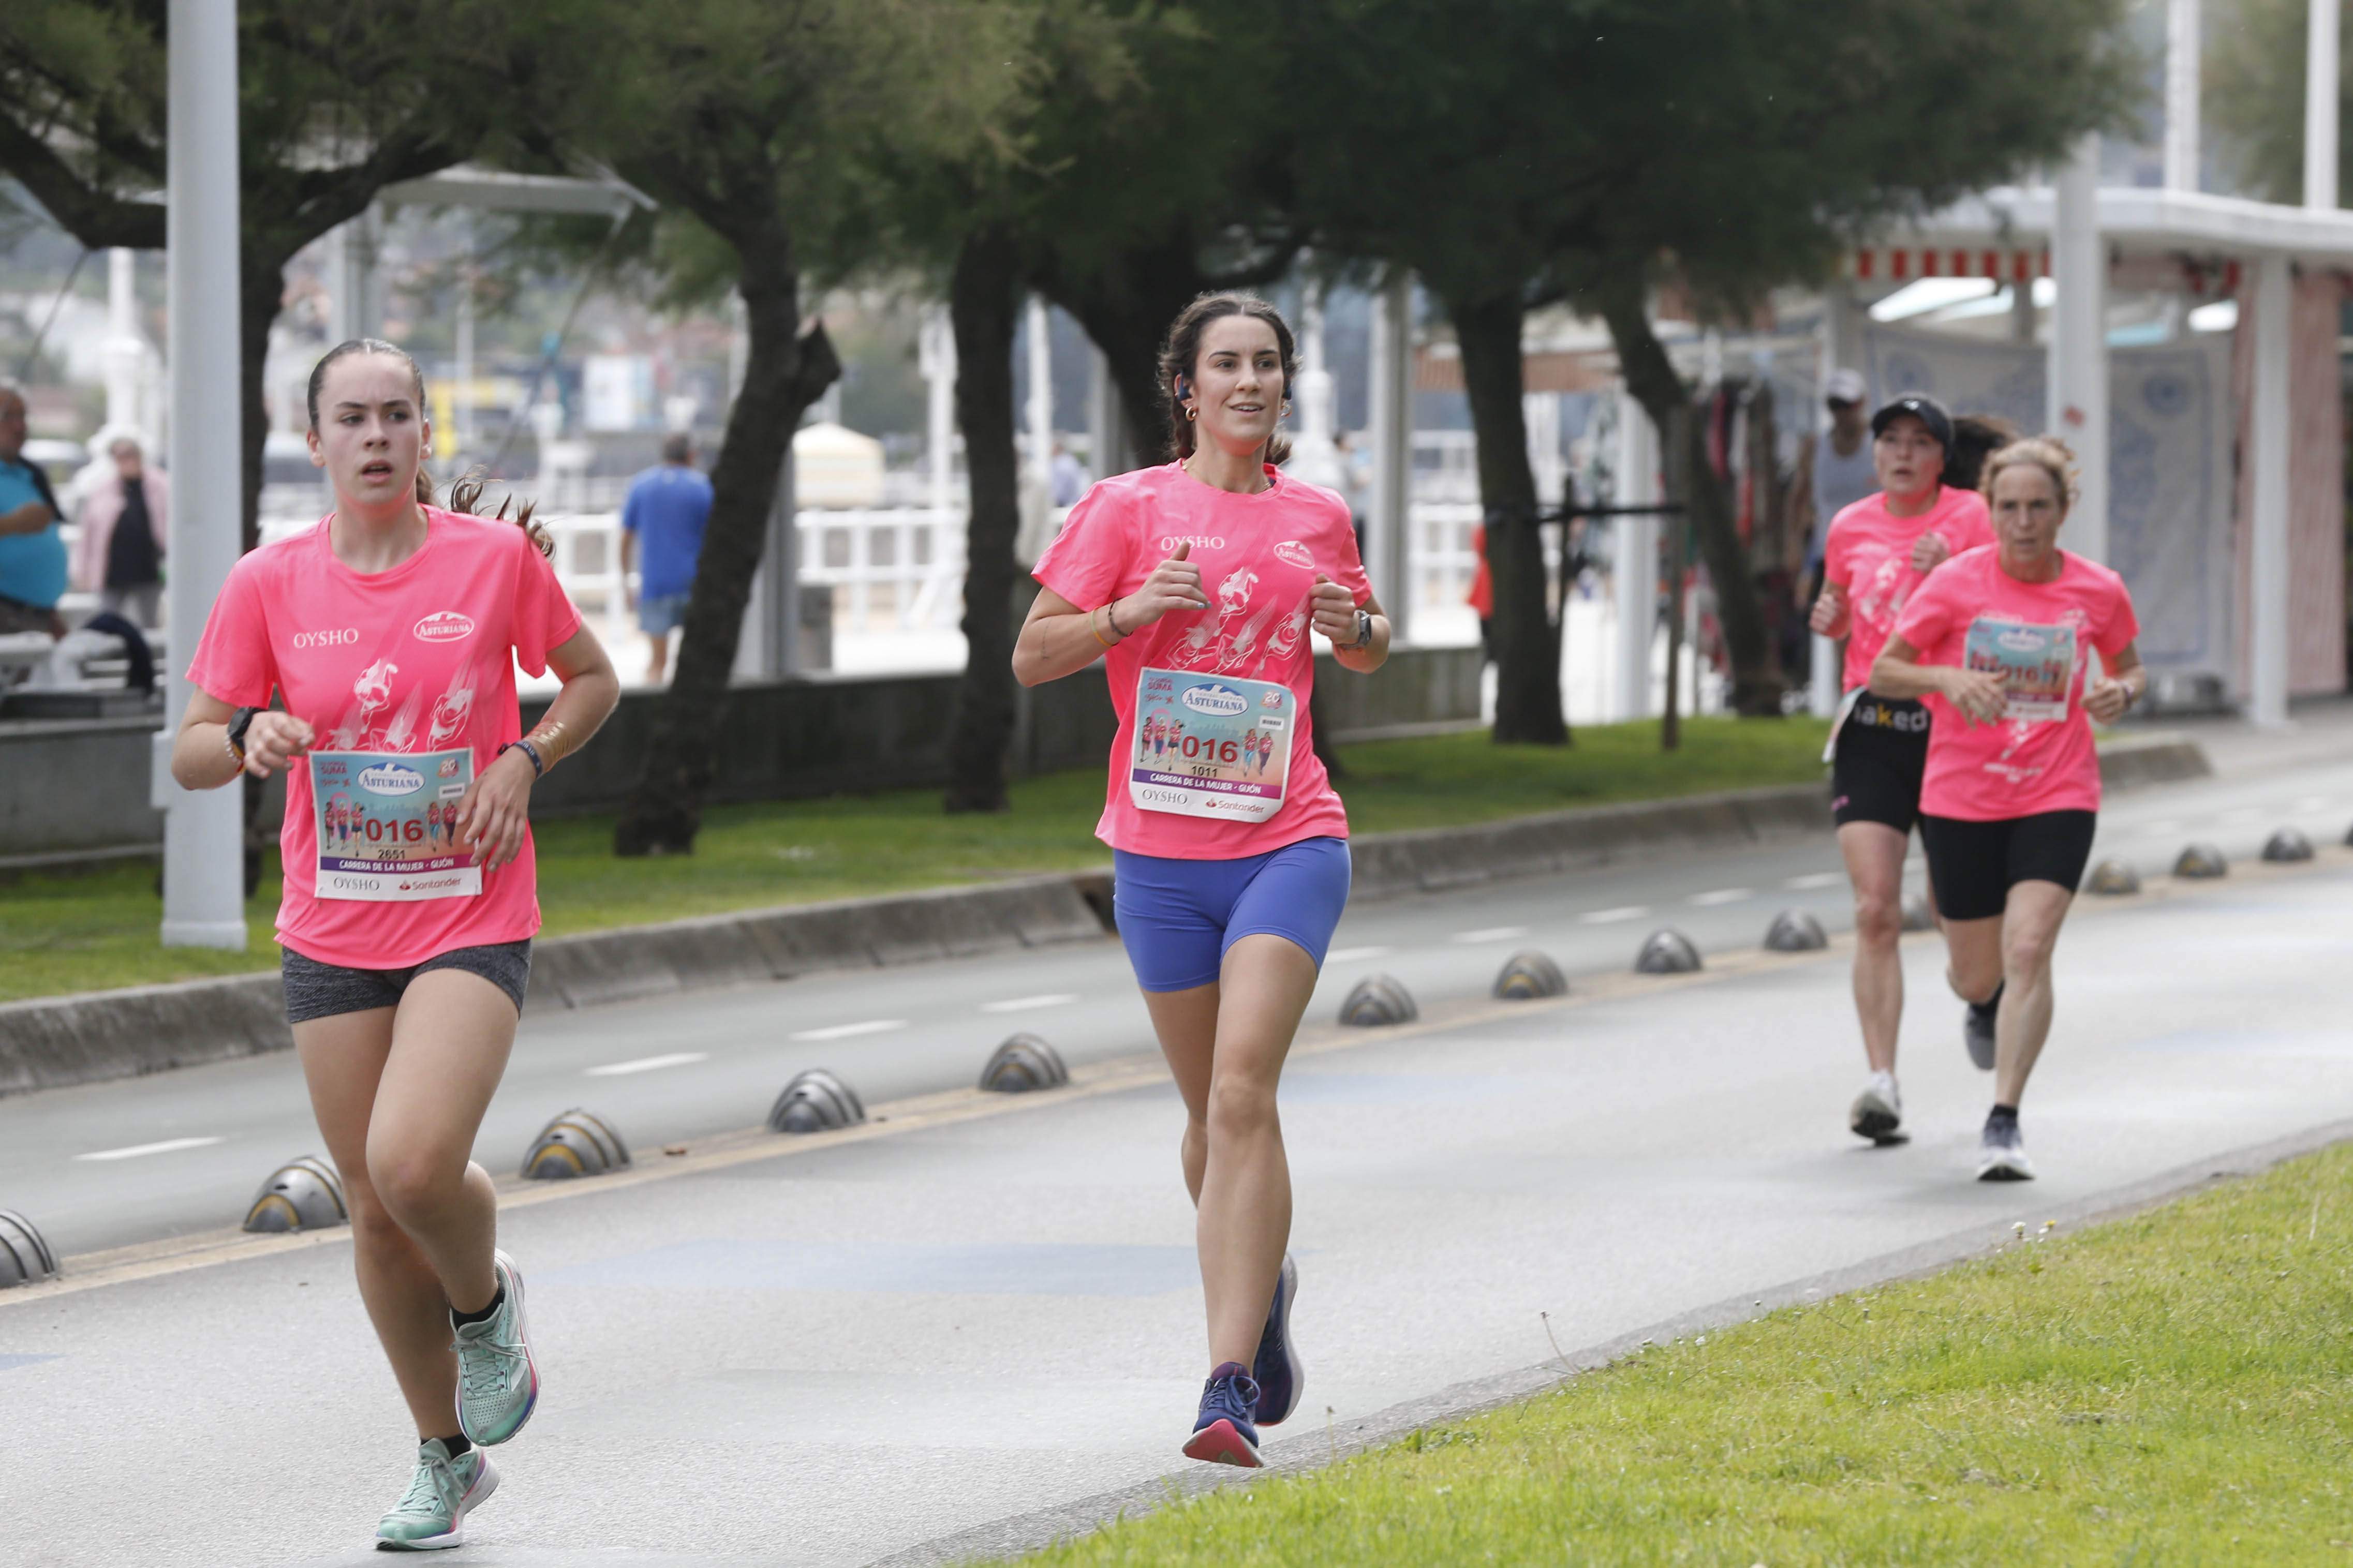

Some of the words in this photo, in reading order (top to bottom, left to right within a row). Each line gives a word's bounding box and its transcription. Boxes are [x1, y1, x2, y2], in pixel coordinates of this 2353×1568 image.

[1161, 535, 1225, 551] OYSHO
[417, 624, 470, 636] ASTURIANA
[293, 628, 359, 648] OYSHO
[1185, 692, 1244, 711] ASTURIANA
[1182, 736, 1238, 763] 016
[1192, 766, 1217, 778] 1011
[362, 773, 420, 788] ASTURIANA
[1150, 773, 1182, 785] CARRERA
[1183, 778, 1194, 786] DE
[1194, 780, 1205, 788] LA
[1206, 781, 1233, 791] MUJER
[1142, 788, 1188, 805] OYSHO
[1218, 800, 1265, 813] Santander
[365, 818, 424, 842] 016
[378, 849, 406, 859] 2651
[339, 860, 372, 870] CARRERA
[372, 862, 383, 871] DE
[384, 862, 395, 871] LA
[396, 861, 424, 872] MUJER
[333, 877, 380, 891] OYSHO
[412, 877, 462, 890] Santander
